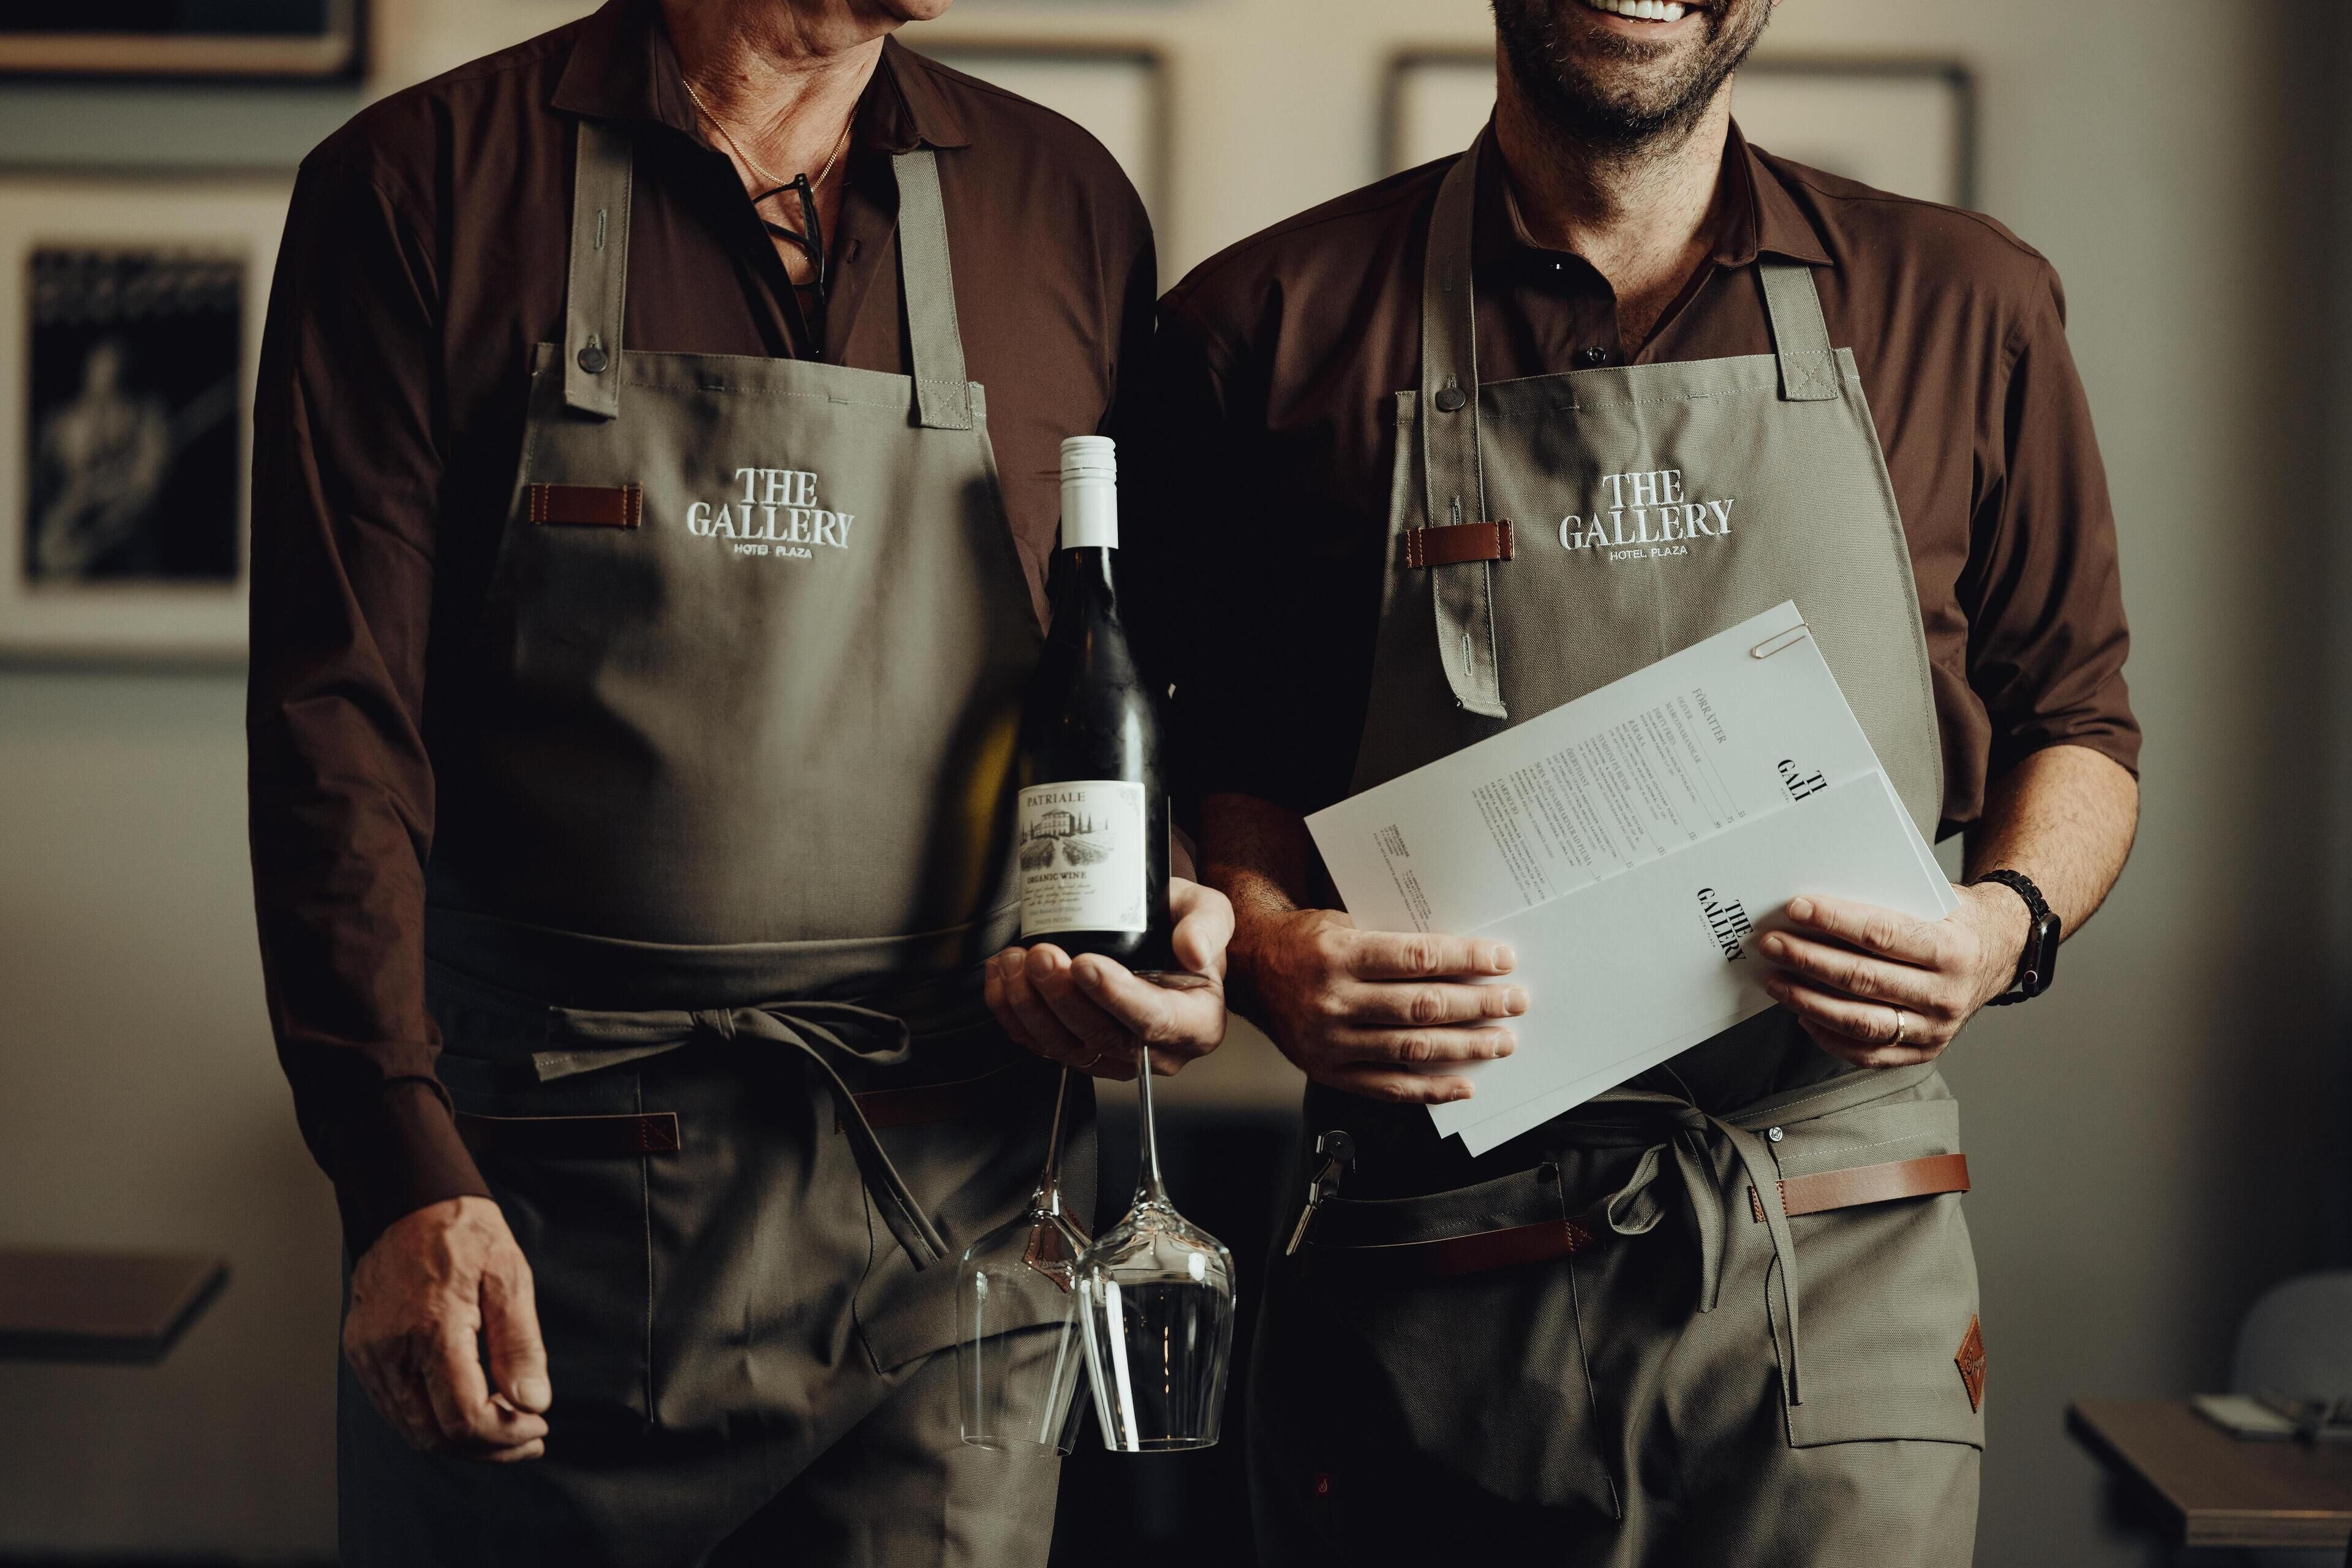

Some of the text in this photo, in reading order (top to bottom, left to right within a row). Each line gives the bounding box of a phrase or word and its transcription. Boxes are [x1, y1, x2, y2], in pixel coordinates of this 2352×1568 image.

[735, 467, 817, 508] THE
[1602, 469, 1684, 509] THE
[687, 502, 855, 549] GALLERY
[1559, 499, 1735, 550] GALLERY
[734, 544, 813, 559] HOTEL PLAZA
[1610, 545, 1687, 560] HOTEL PLAZA
[1691, 686, 1729, 744] FÖRRÄTTER
[1806, 770, 1830, 794] TH
[1027, 791, 1085, 807] PATRIALE
[1496, 777, 1520, 815] CARPACCIO
[1725, 815, 1734, 824] 75
[1687, 831, 1697, 841] 135
[1657, 845, 1667, 856] 135
[1027, 871, 1087, 884] ORGANIC WINE
[1697, 888, 1746, 963] GALLERY
[1698, 914, 1707, 930] HOTEL
[1725, 899, 1754, 938] THE
